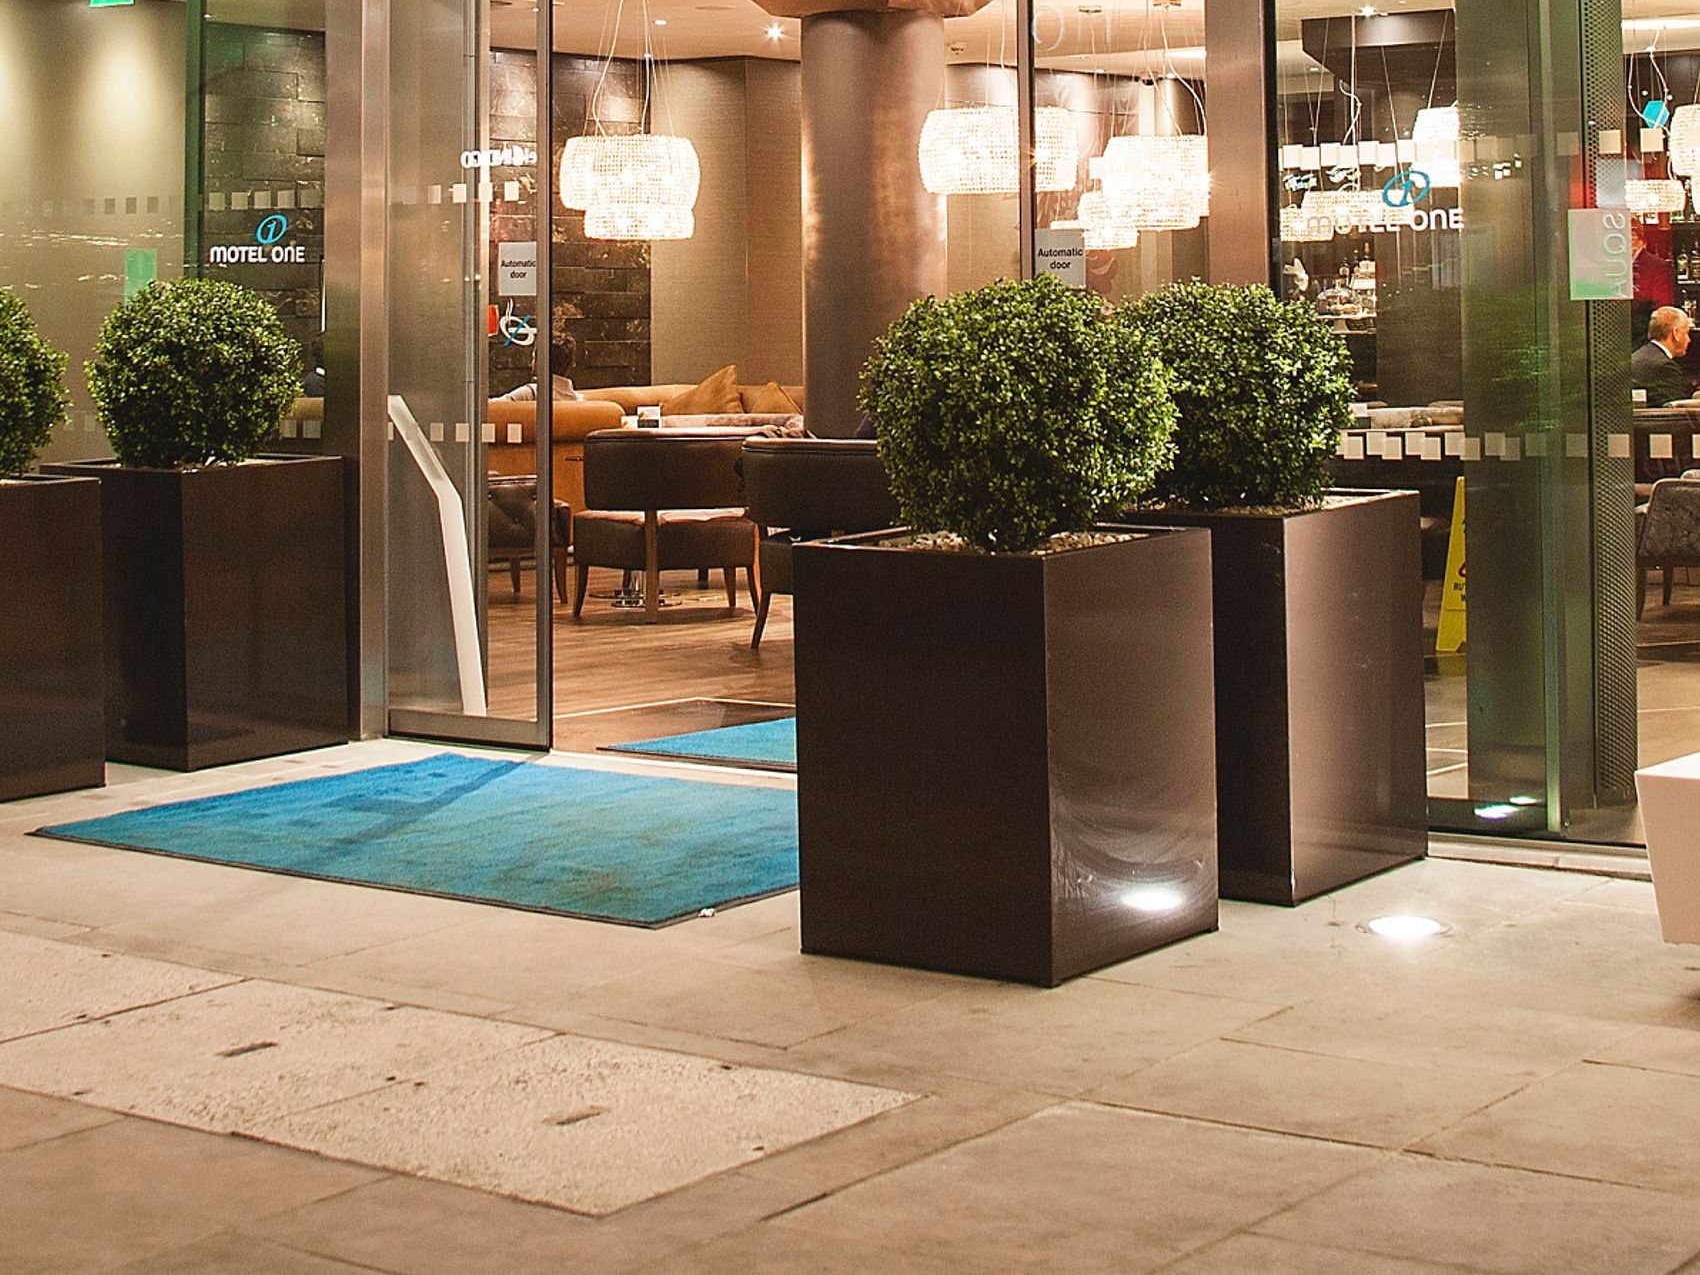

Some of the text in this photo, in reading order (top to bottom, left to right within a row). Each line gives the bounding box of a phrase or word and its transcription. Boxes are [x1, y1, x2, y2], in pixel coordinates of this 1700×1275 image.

[1038, 247, 1083, 257] Automatic
[501, 259, 536, 268] Automatic
[1049, 260, 1071, 270] door
[510, 270, 526, 279] door
